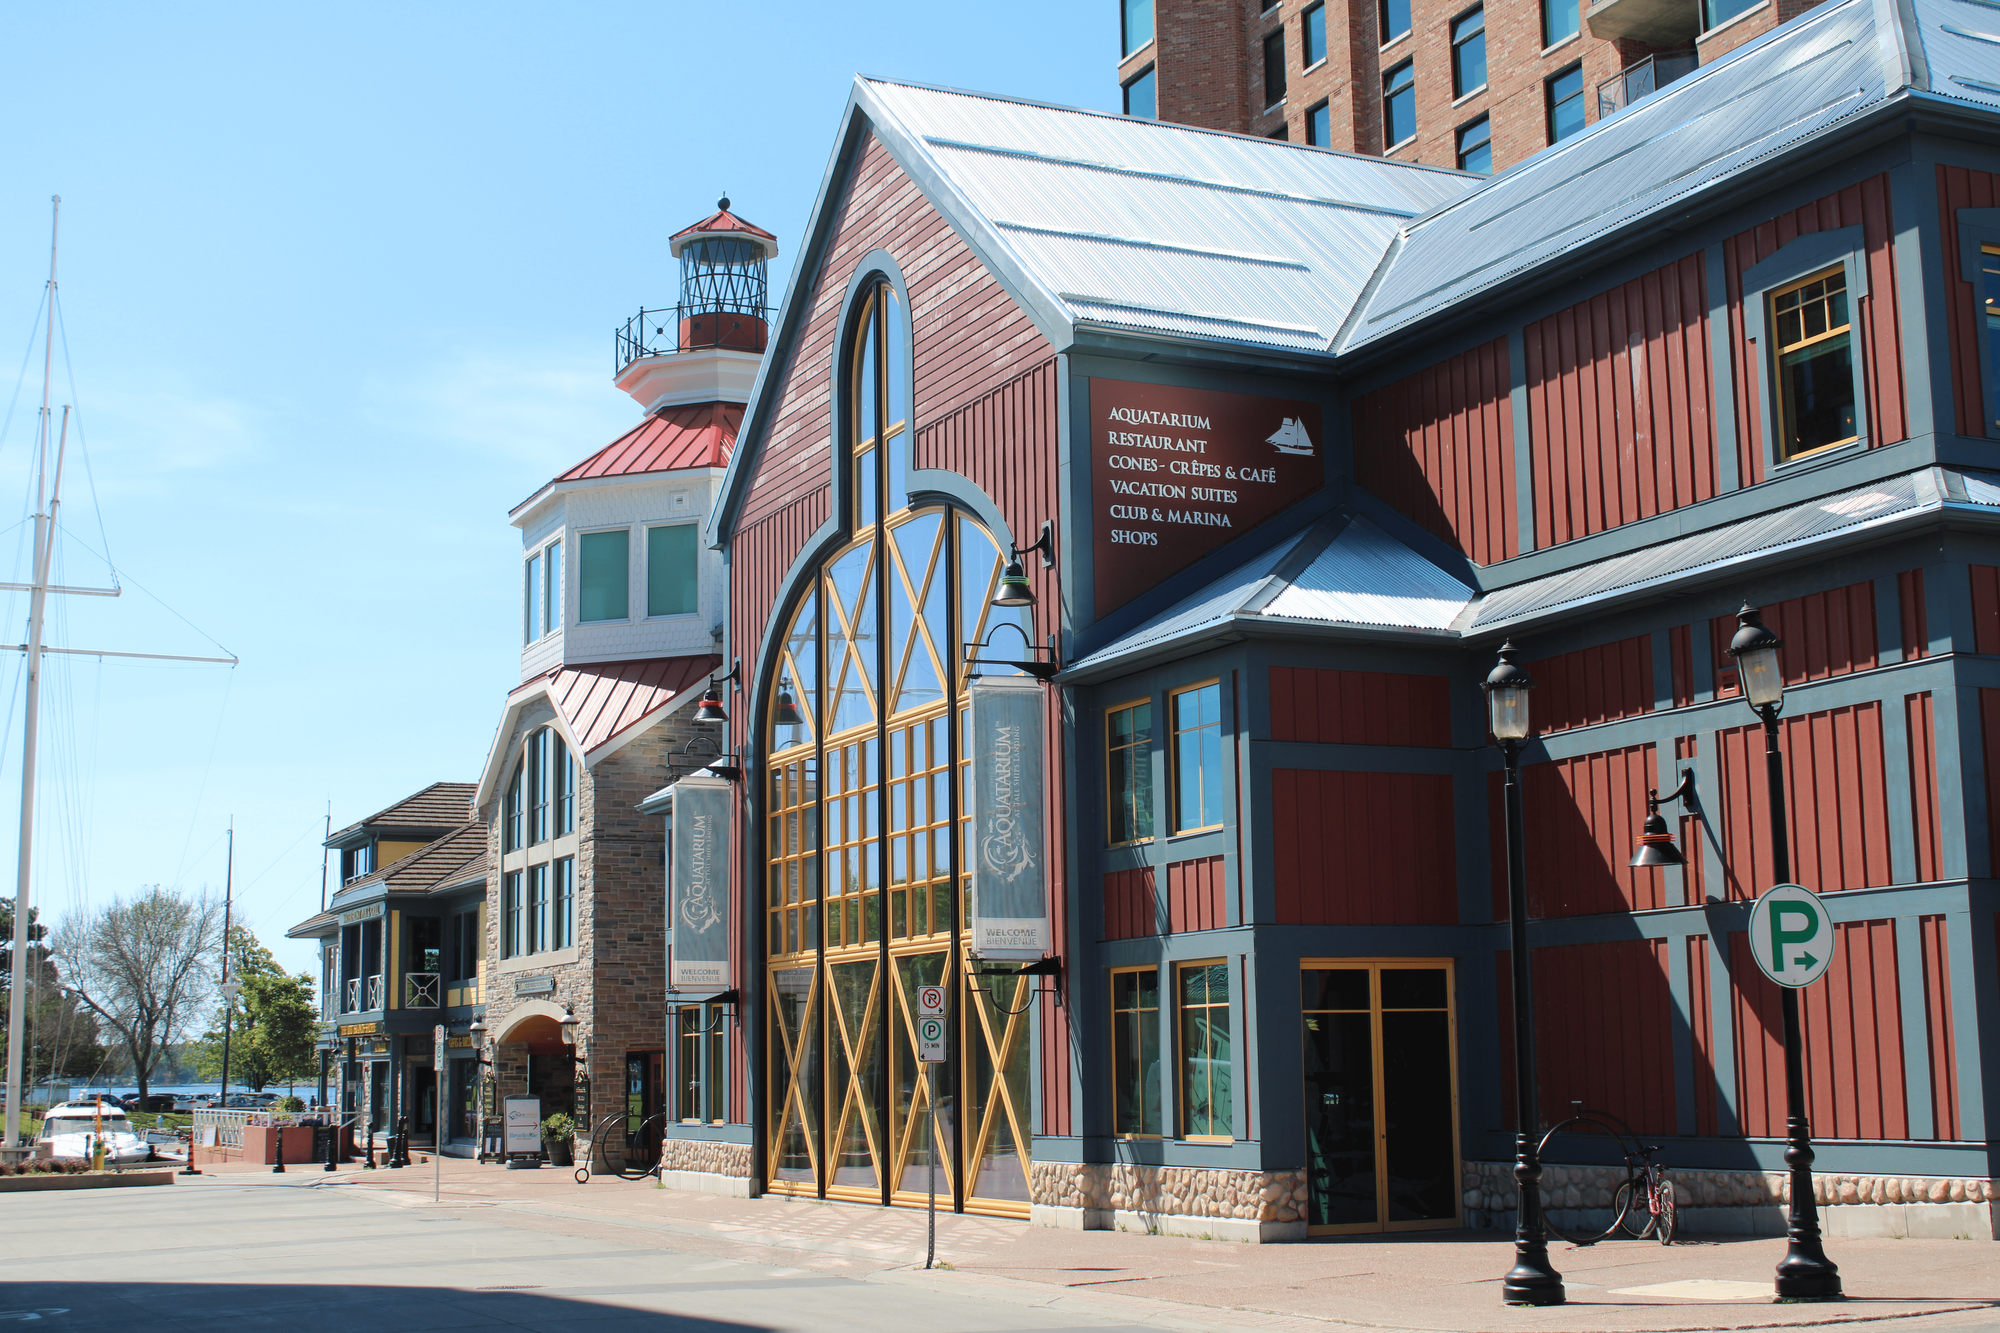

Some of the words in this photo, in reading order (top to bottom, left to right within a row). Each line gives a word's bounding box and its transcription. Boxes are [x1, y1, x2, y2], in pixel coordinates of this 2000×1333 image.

[1108, 407, 1211, 430] AQUATARIUM
[1108, 431, 1207, 453] RESTAURANT
[1170, 459, 1220, 478] CRÊPES
[1225, 466, 1237, 479] &
[1240, 468, 1276, 483] CAFÉ
[1110, 480, 1186, 499] VACATION
[1191, 486, 1237, 504] SUITES
[1110, 505, 1148, 521] CLUB
[1151, 508, 1164, 522] &
[1167, 510, 1232, 527] MARINA
[1111, 529, 1158, 546] SHOPS
[986, 928, 1037, 937] WELCOME
[986, 937, 1037, 945] BIENVENUE
[1769, 900, 1819, 972] P
[928, 1024, 936, 1036] P
